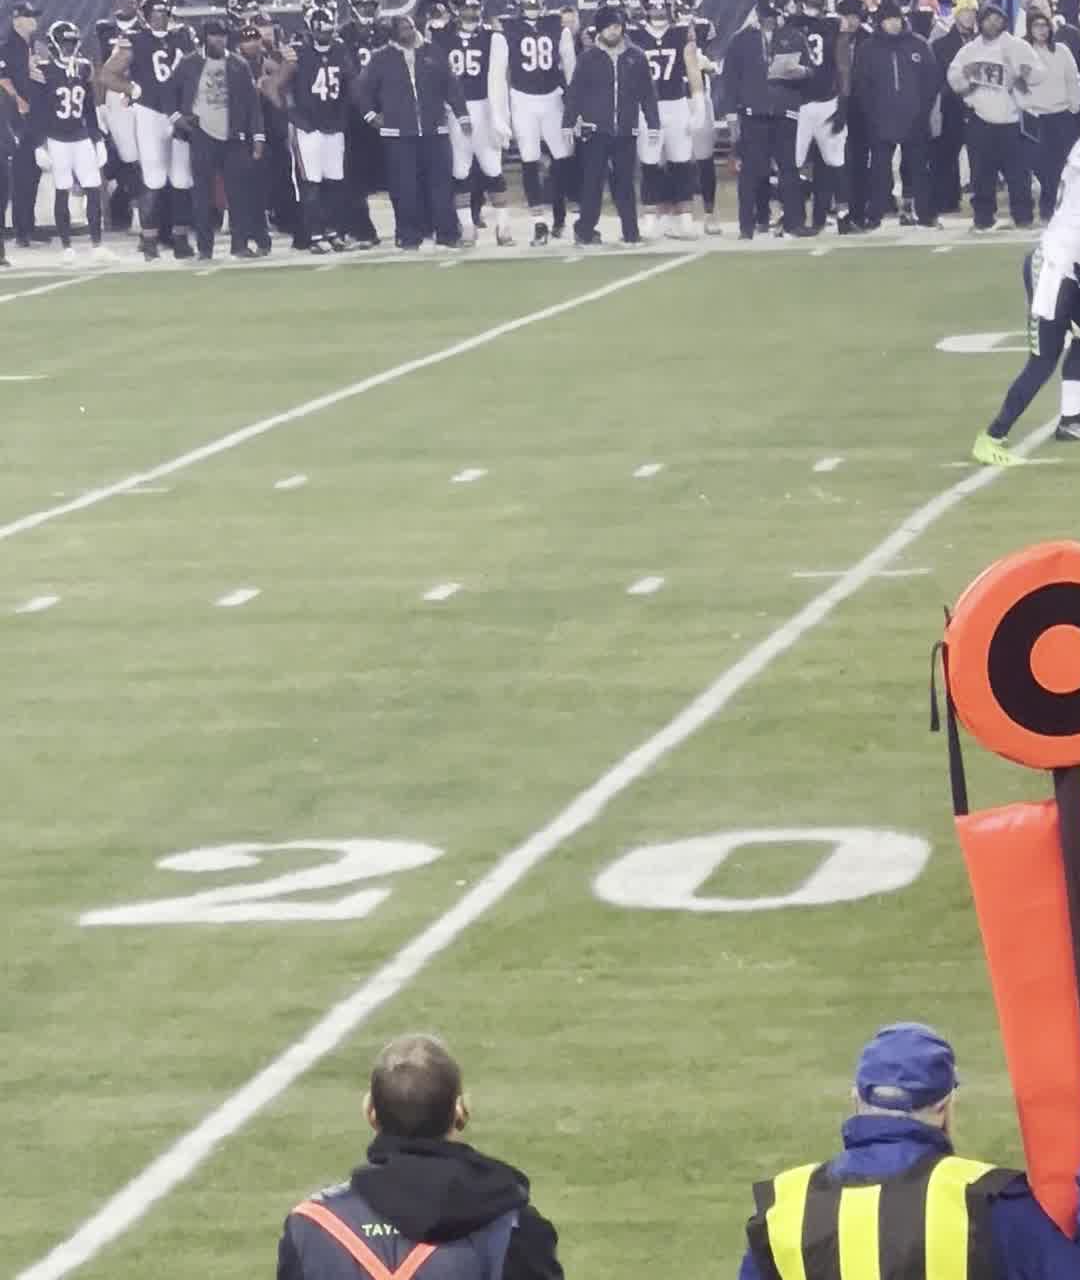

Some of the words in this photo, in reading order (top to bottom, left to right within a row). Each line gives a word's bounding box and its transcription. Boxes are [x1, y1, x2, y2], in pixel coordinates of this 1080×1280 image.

[519, 36, 554, 73] 98
[644, 48, 677, 81] 57
[311, 65, 340, 101] 45
[56, 85, 86, 119] 39
